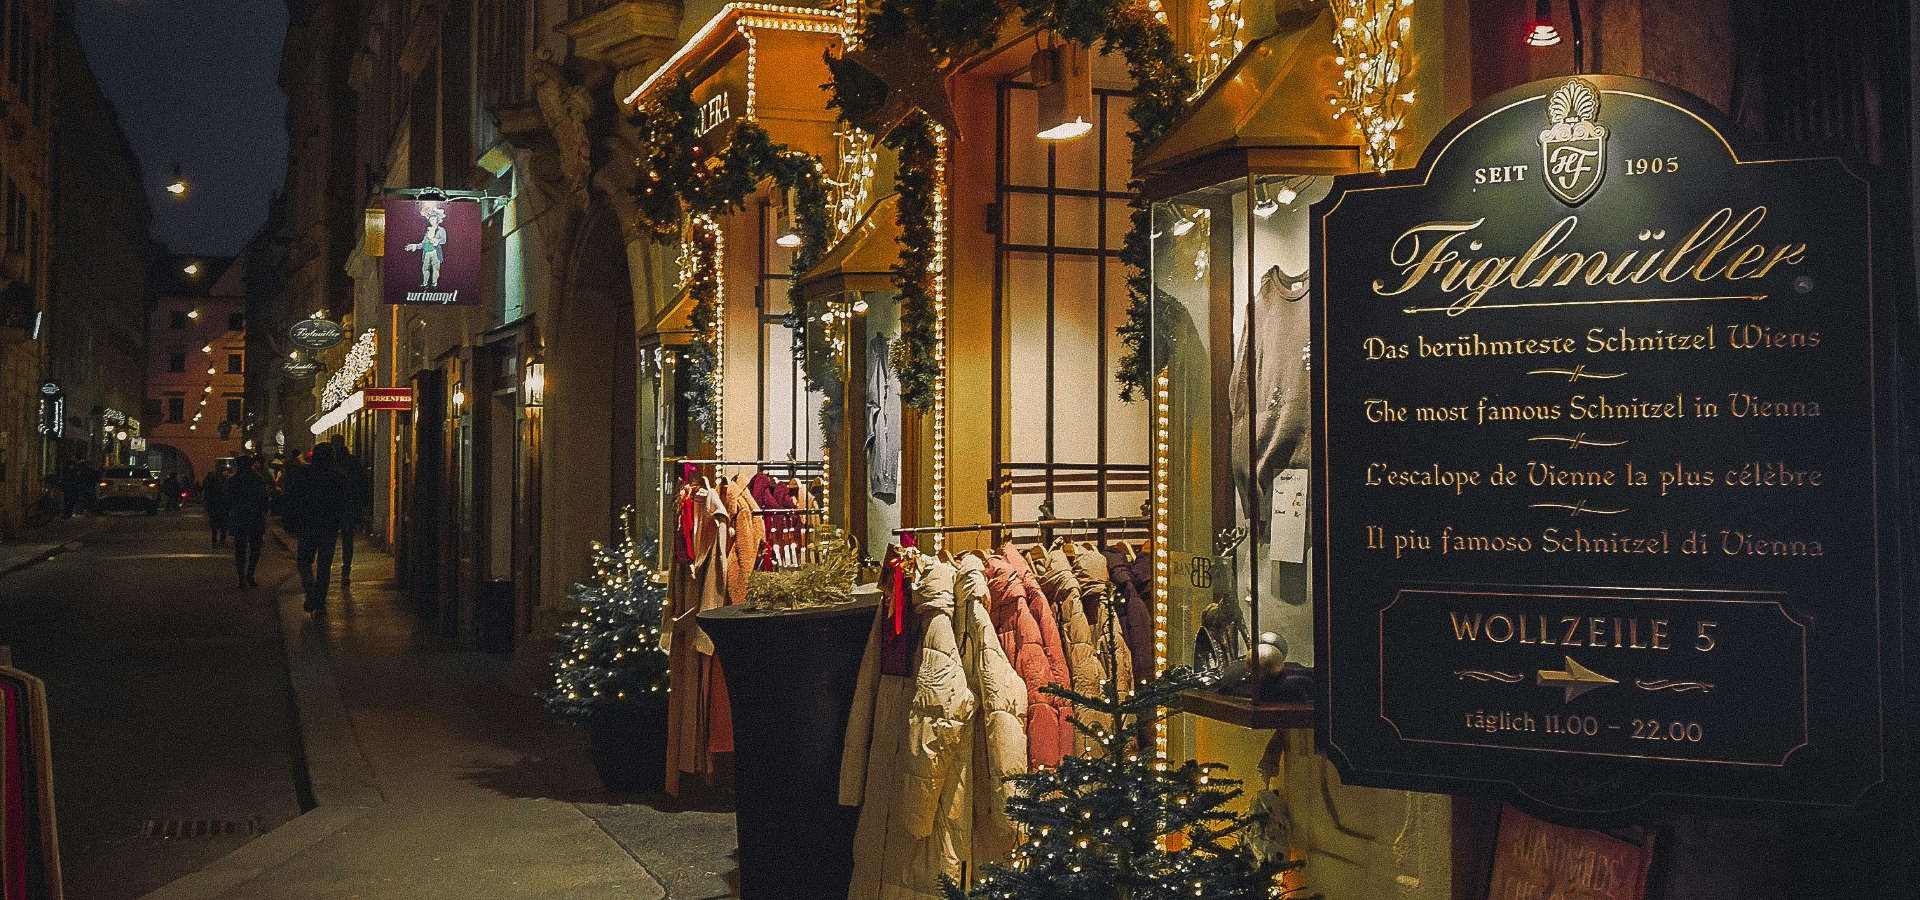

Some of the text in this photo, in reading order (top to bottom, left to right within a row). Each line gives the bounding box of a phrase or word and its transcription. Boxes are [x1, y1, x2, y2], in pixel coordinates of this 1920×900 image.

[1474, 164, 1528, 185] SEIT
[1625, 155, 1679, 176] 1905
[1372, 206, 1807, 317] Figlmüller
[1362, 323, 1821, 361] Das berühmteste Schnitzel Wiens
[1363, 391, 1821, 426] The most famous Schnitzel in Vienna
[1364, 460, 1822, 497] L'escalope de Vienne la plus célèbre
[1366, 524, 1824, 560] Il piu famoso Schnitzel di Vienna
[1449, 612, 1718, 653] WOLLZEILE 5
[1465, 709, 1537, 734] täglich
[1544, 714, 1599, 737] 11.00
[1631, 718, 1703, 743] 22.00
